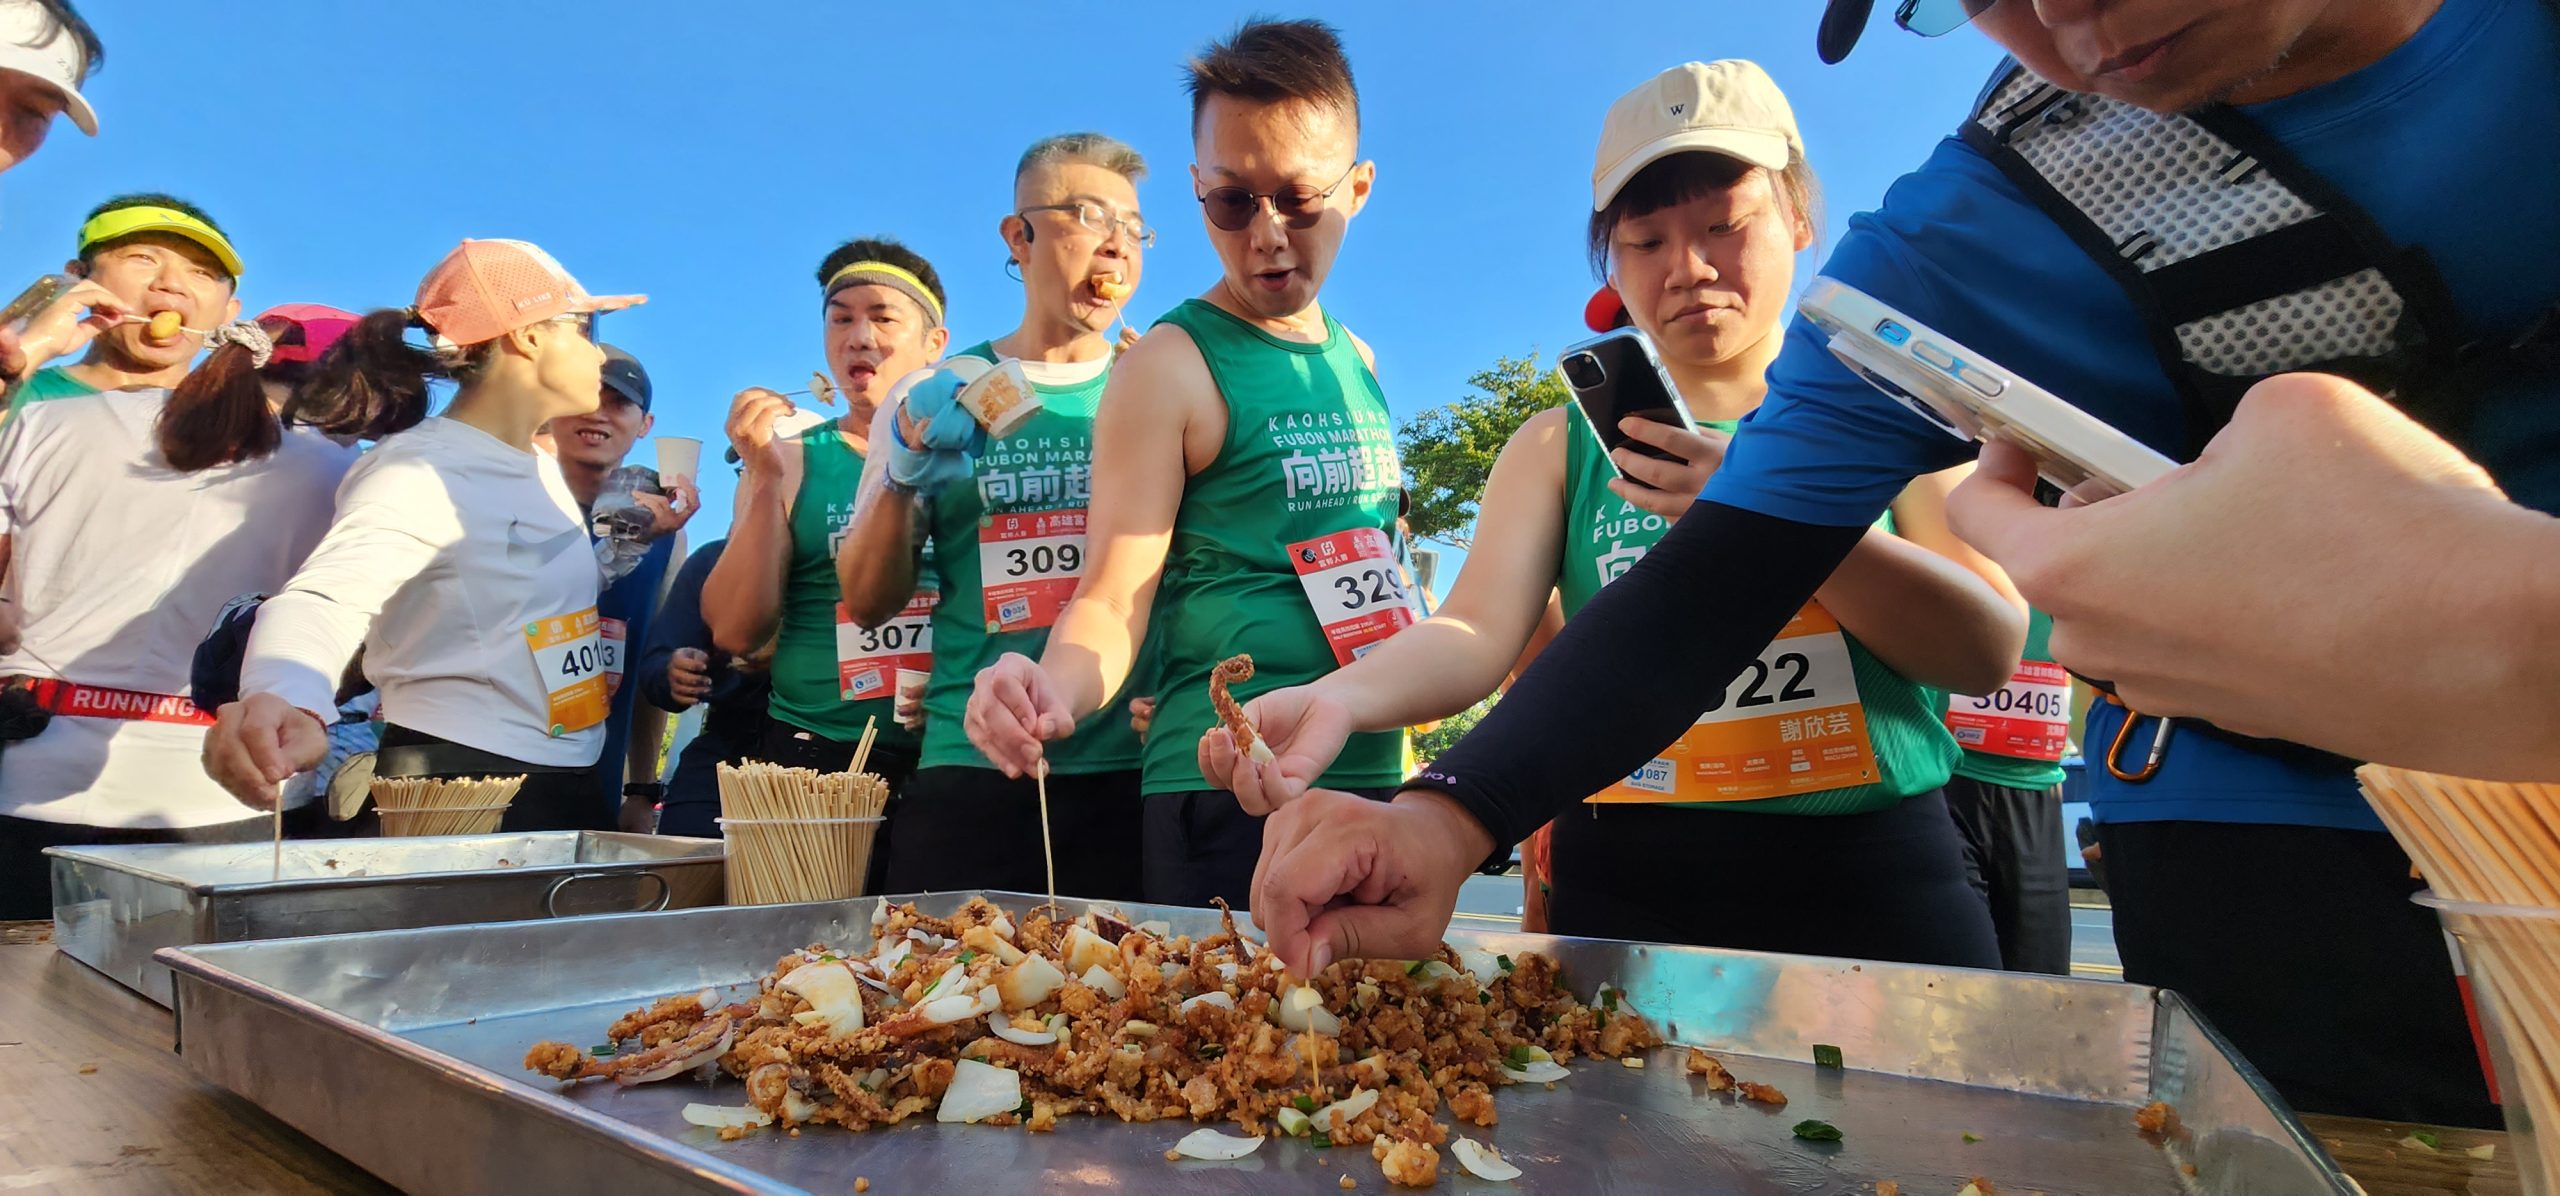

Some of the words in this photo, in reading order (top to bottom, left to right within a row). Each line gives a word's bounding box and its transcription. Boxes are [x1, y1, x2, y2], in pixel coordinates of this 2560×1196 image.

[1670, 103, 1685, 117] W
[1268, 410, 1387, 432] KAOHSIUNG
[1272, 431, 1327, 448] FUBON
[975, 451, 1039, 468] FUBON
[1281, 445, 1402, 499] 向前超越
[1287, 501, 1312, 512] RUN
[1315, 497, 1344, 510] AHEAD
[72, 689, 196, 718] RUNNING
[1779, 711, 1851, 743] 謝欣芸
[1646, 768, 1668, 782] 087
